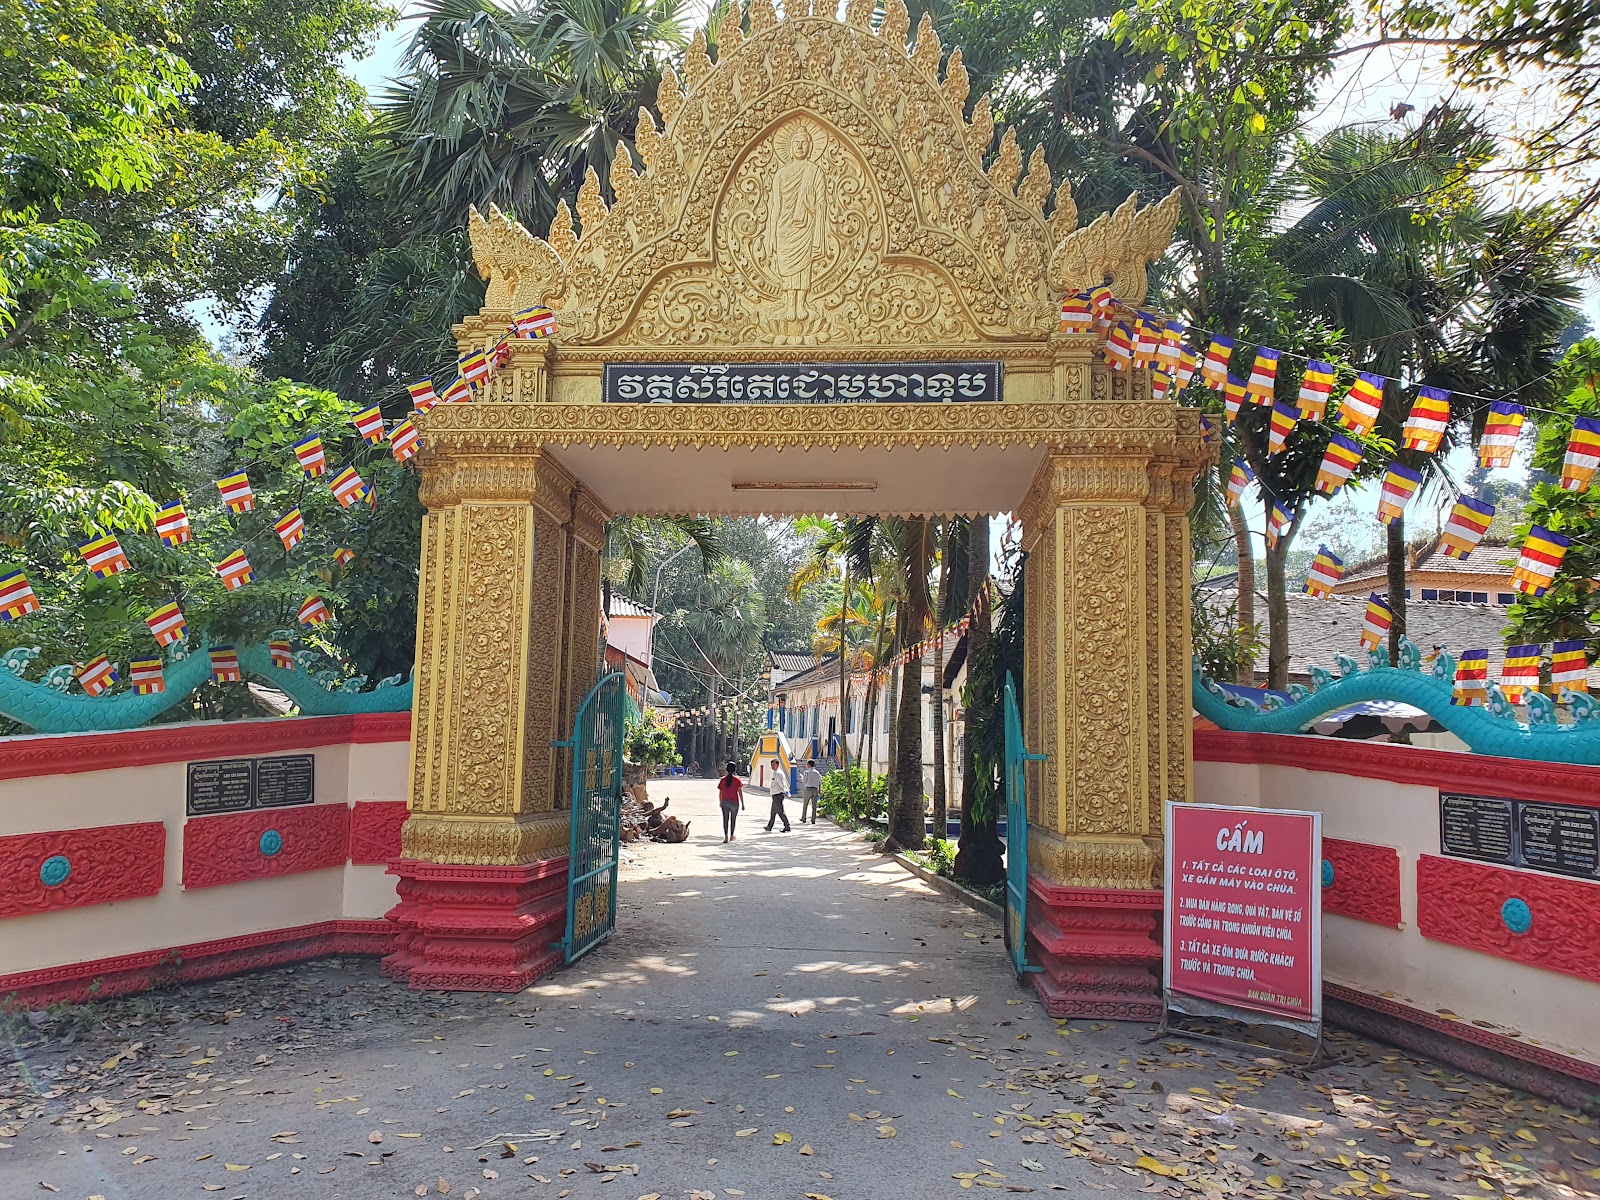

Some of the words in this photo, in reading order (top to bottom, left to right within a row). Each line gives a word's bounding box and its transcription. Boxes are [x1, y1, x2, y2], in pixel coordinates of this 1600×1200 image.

[1217, 820, 1263, 854] CẤM
[1192, 859, 1210, 870] TẤT
[1212, 861, 1224, 872] CẢ
[1227, 864, 1246, 874] CÁC
[1249, 868, 1271, 879] LOẠI
[1182, 874, 1194, 882] XE
[1219, 877, 1242, 888] MÁY
[1244, 879, 1263, 890] VÀO
[1267, 883, 1296, 894] CHÙA.
[1185, 898, 1197, 909] MUA
[1199, 897, 1210, 910] BÁN
[1211, 899, 1226, 912] HÀNG
[1245, 903, 1256, 916] QUÀ
[1272, 906, 1284, 919] BÁN
[1285, 905, 1292, 921] VÉ
[1294, 907, 1302, 922] SỐ
[1180, 914, 1196, 927] TRƯỚC
[1198, 913, 1212, 930] CỔNG
[1213, 917, 1220, 930] VÀ
[1222, 920, 1240, 933] TRONG
[1241, 922, 1261, 935] KHUÔN
[1262, 924, 1275, 938] VIÊN
[1277, 926, 1293, 940] CHÙA.
[1188, 938, 1200, 952] TẤT
[1202, 940, 1209, 954] CẢ
[1212, 944, 1221, 956] XE
[1222, 944, 1233, 958] ÔM
[1235, 947, 1248, 960] ĐƯA
[1250, 949, 1268, 963] RƯỚC
[1270, 952, 1294, 967] KHÁCH
[1181, 958, 1200, 971] TRƯỚC
[1203, 960, 1210, 973] VÀ
[1213, 963, 1235, 977] TRONG
[1237, 966, 1256, 980] CHÙA.
[1248, 989, 1259, 998] BAN
[1260, 990, 1275, 1002] QUẢN
[1287, 995, 1301, 1007] CHÙA
